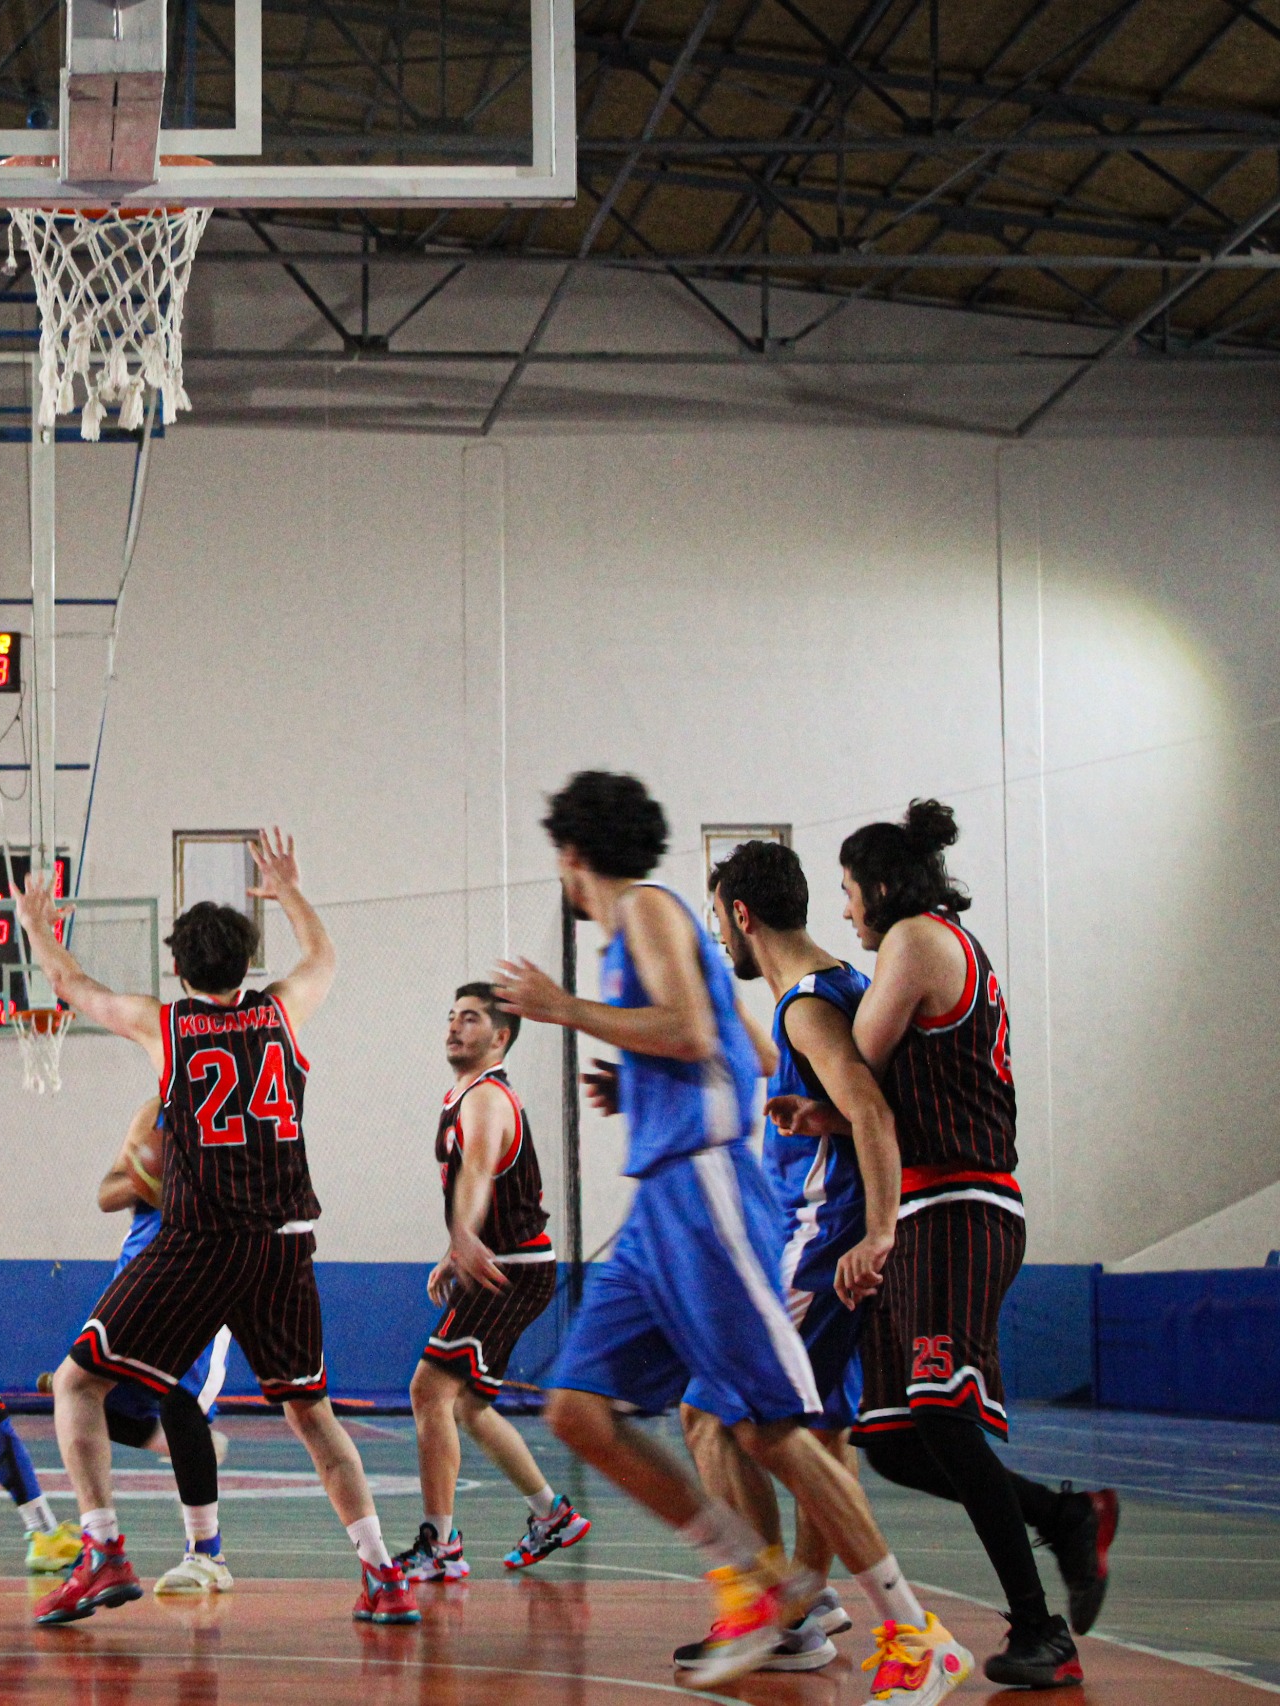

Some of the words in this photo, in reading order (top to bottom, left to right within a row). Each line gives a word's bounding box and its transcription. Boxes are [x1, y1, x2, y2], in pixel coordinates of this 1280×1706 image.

[178, 1005, 281, 1038] KOCAMAZ
[186, 1041, 299, 1147] 24
[911, 1334, 955, 1380] 25
